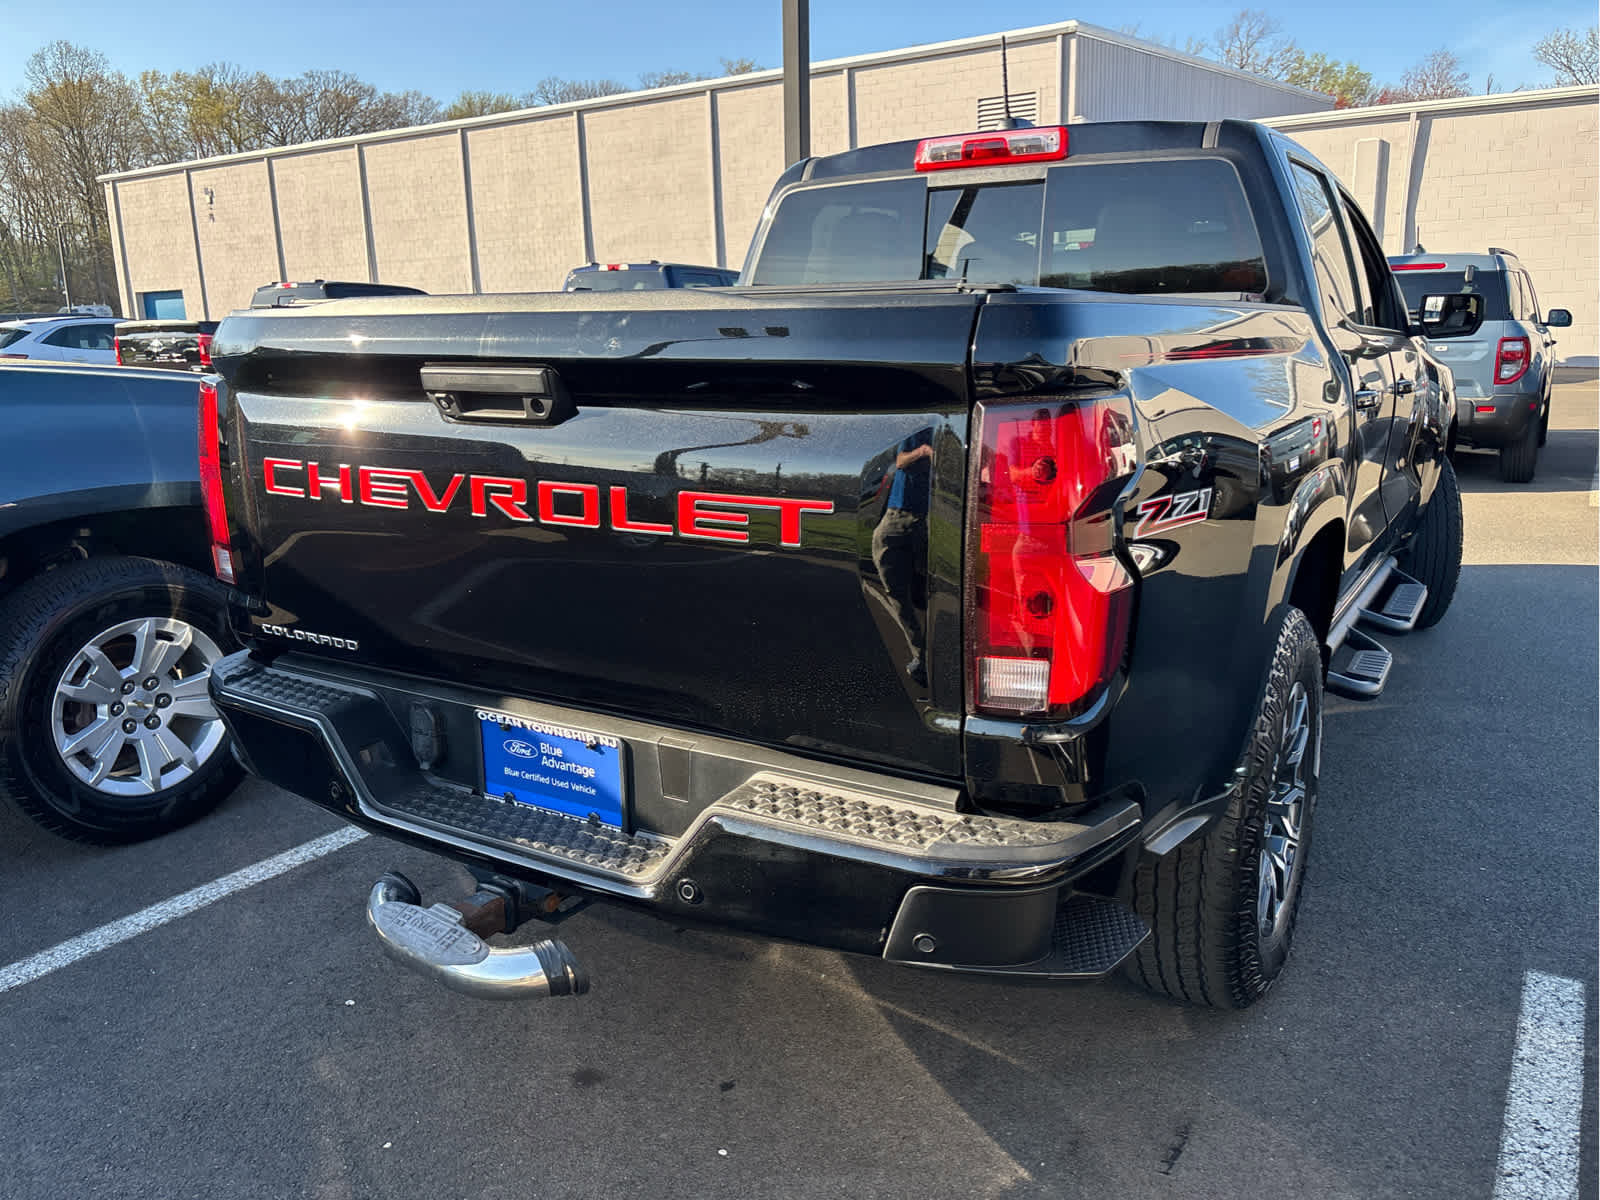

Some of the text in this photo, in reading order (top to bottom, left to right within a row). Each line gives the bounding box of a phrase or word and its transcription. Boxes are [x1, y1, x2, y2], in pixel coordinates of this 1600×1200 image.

[263, 456, 834, 548] CHEVROLET
[1133, 487, 1213, 540] Z71
[261, 623, 359, 651] COLORADO
[477, 710, 617, 749] OCEAN TOWNSHIP NJ
[540, 742, 563, 758] Blue
[541, 755, 596, 778] Advantage
[504, 767, 596, 796] Blue Certified Used Vehicle
